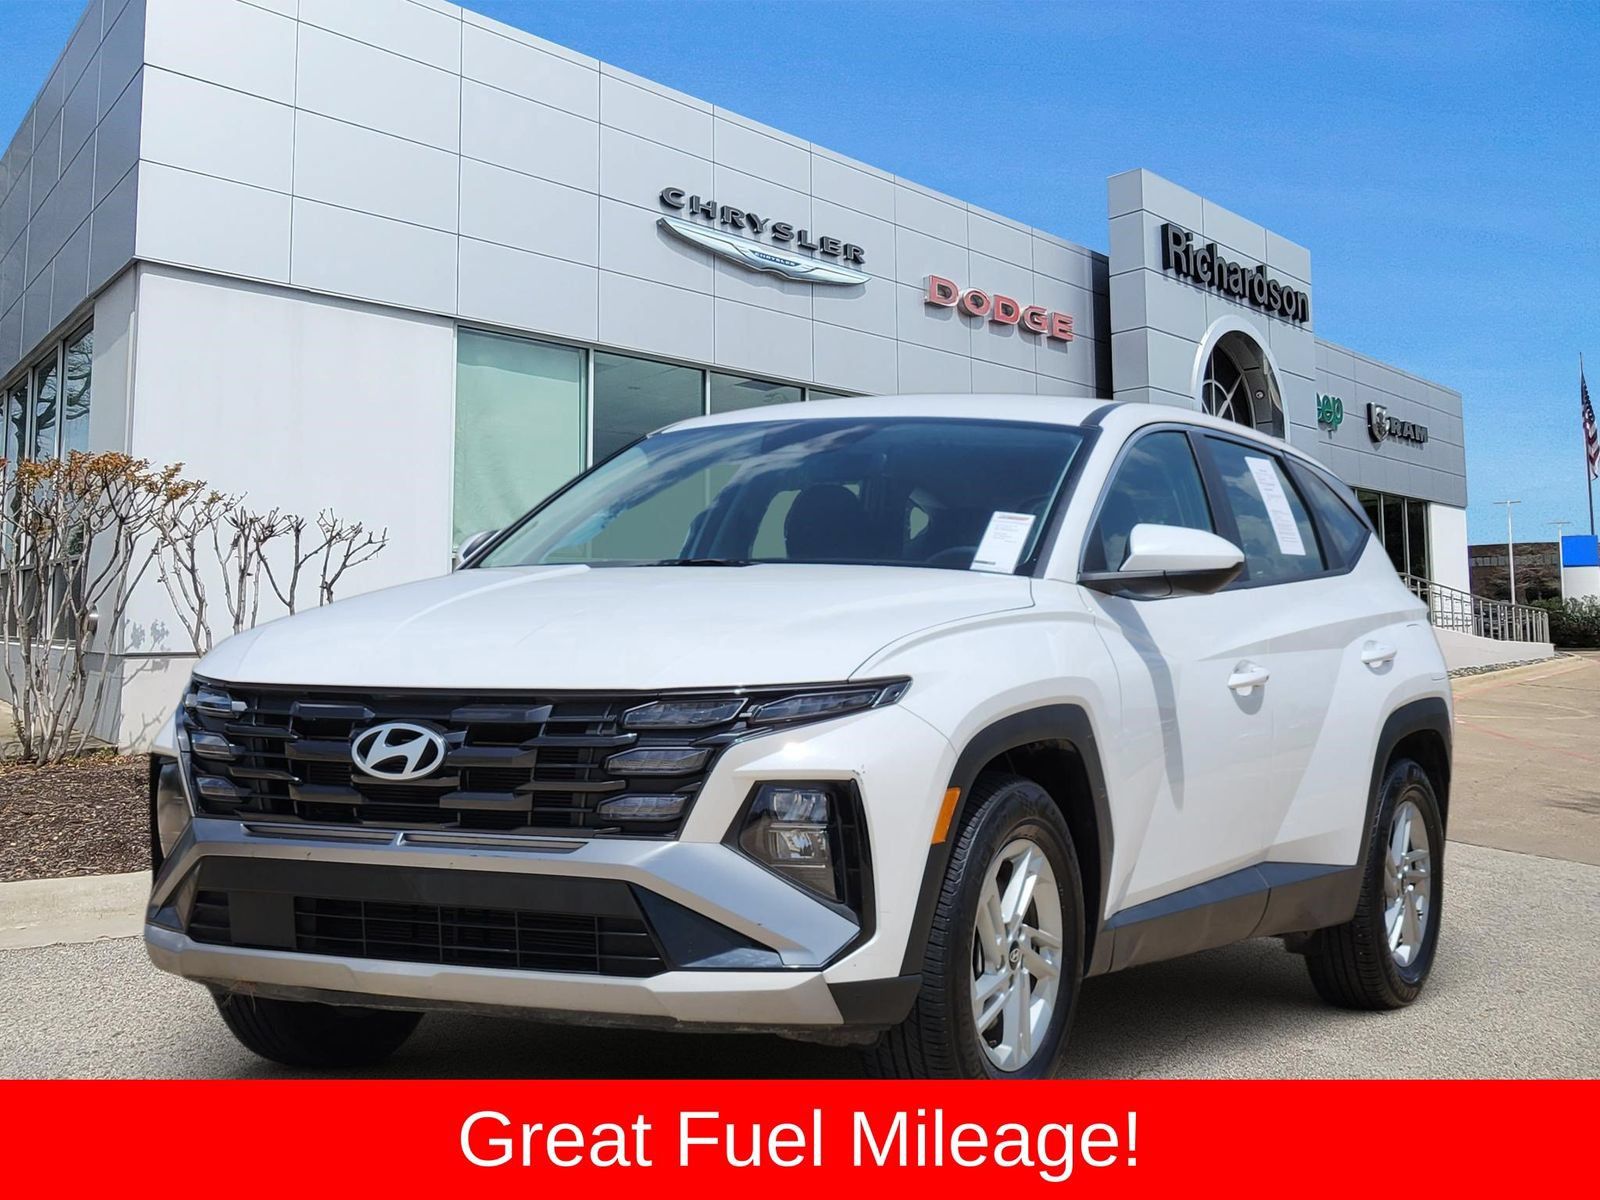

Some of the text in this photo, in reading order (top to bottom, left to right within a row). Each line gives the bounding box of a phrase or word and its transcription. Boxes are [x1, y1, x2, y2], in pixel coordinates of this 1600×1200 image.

[659, 187, 866, 264] CHRYSLER
[924, 274, 1074, 342] DODGE
[1161, 223, 1309, 323] Richardson
[1387, 416, 1428, 443] RAM
